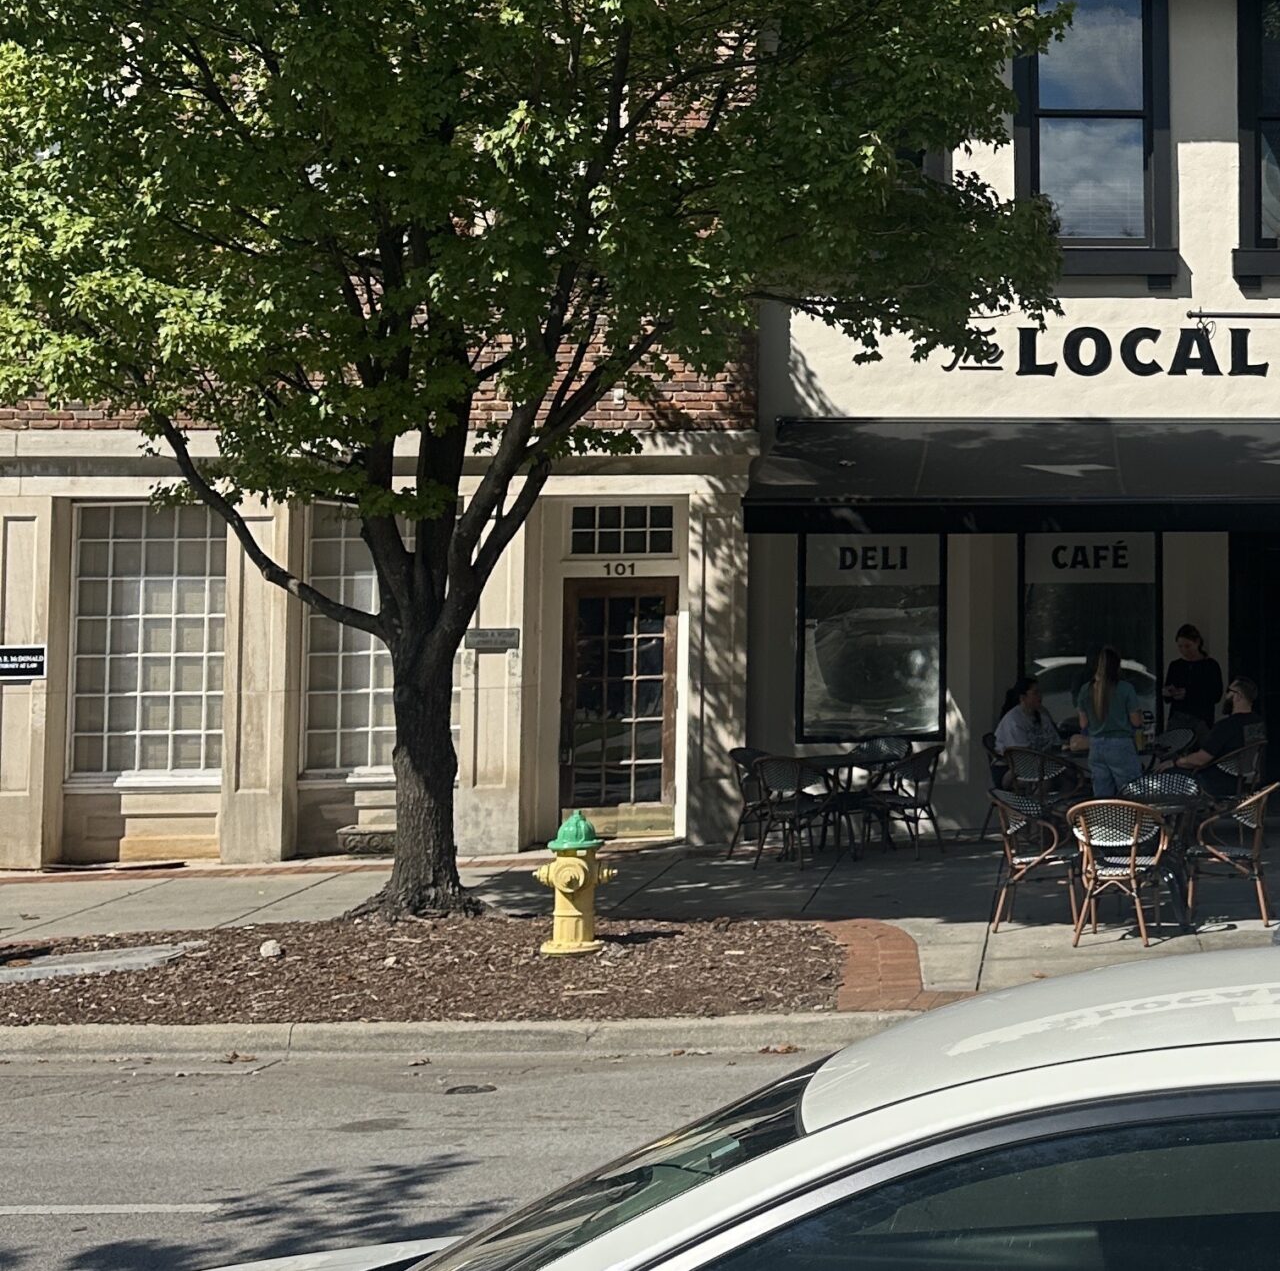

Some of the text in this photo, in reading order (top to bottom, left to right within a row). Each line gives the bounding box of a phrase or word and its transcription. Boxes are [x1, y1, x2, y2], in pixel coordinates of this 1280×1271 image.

[1015, 326, 1269, 377] LOCAL
[838, 546, 909, 570] DELI
[1051, 540, 1129, 569] CAFÉ
[603, 562, 635, 576] 101
